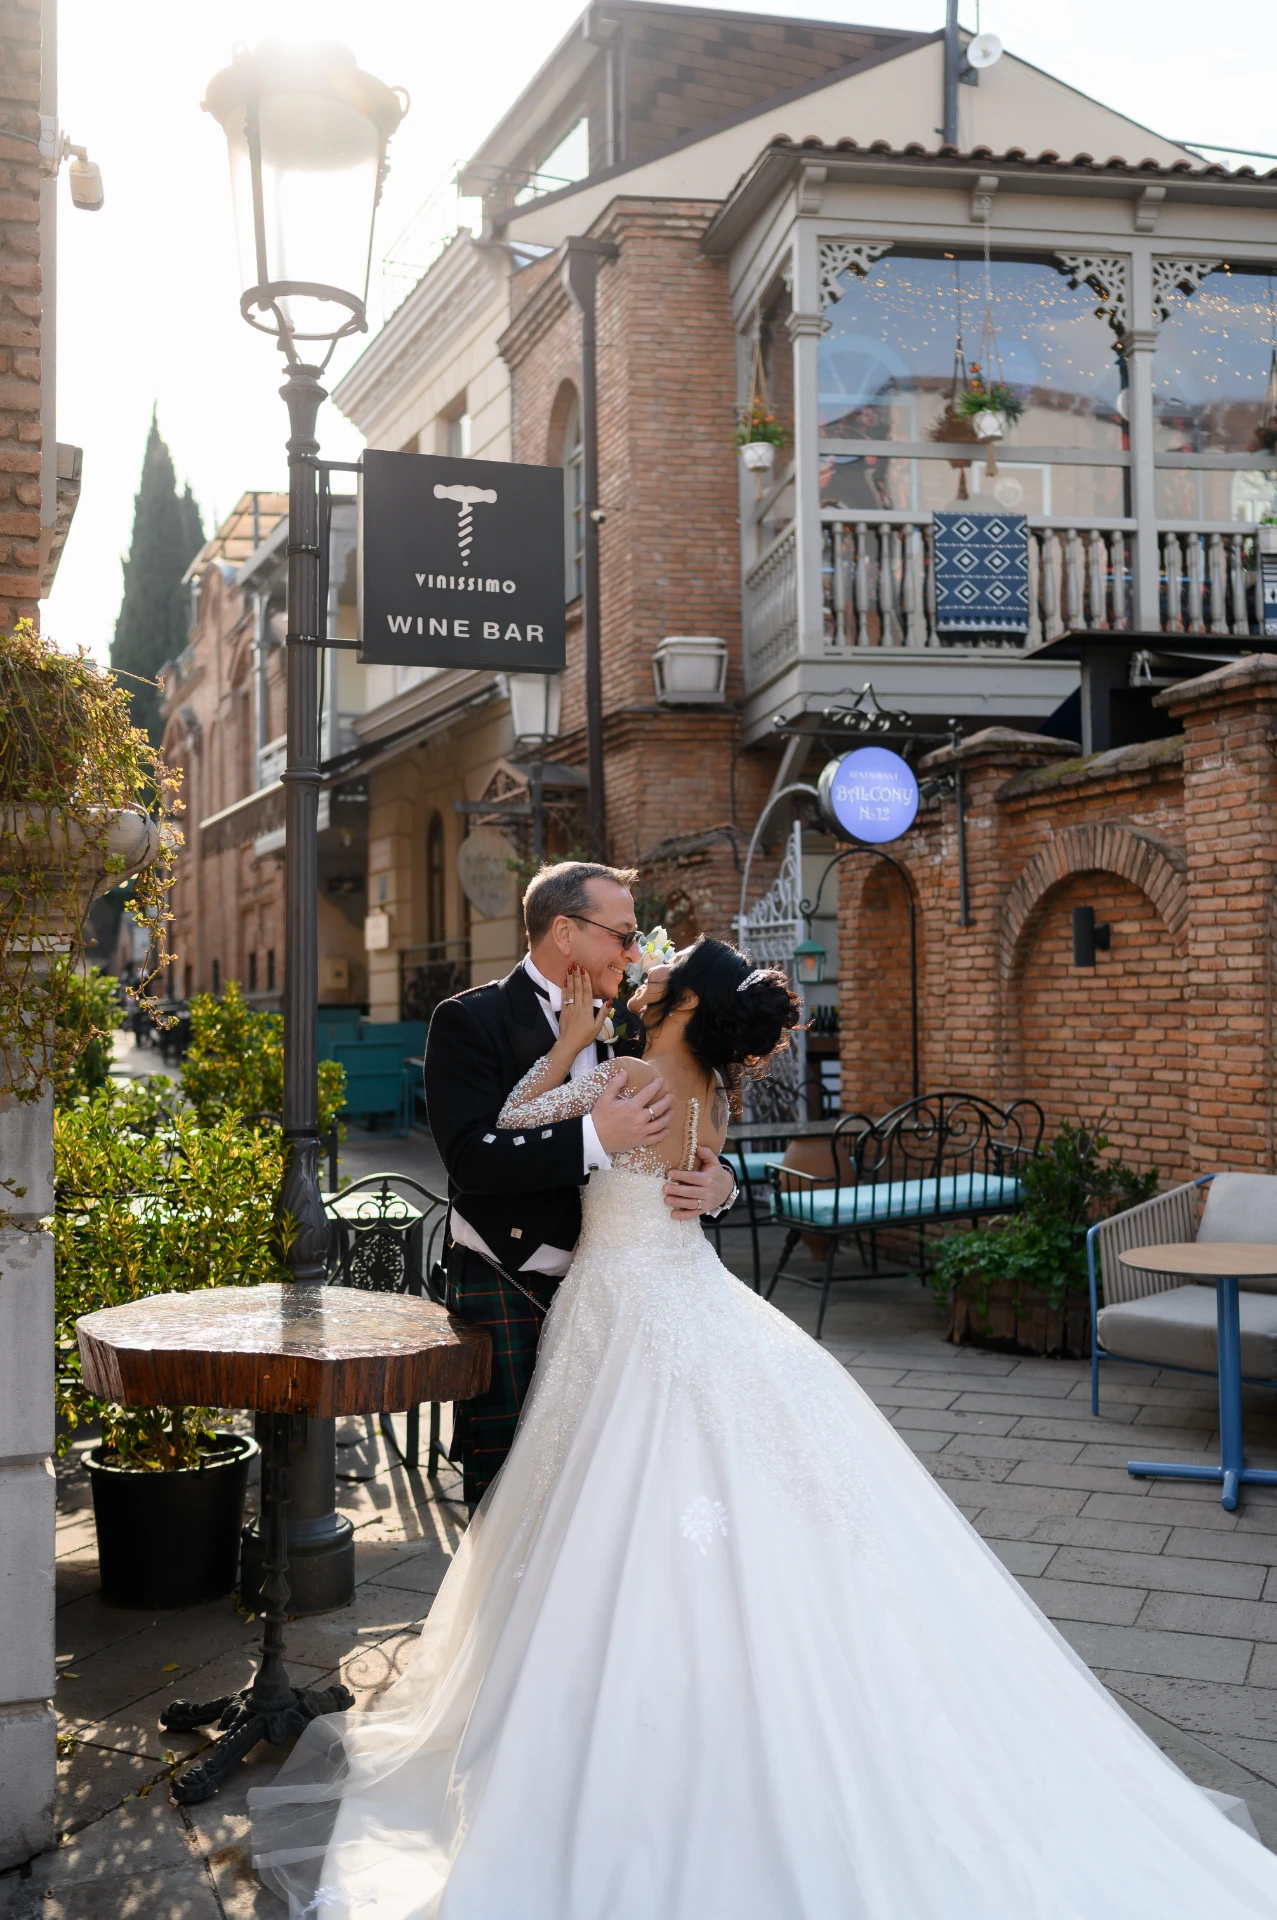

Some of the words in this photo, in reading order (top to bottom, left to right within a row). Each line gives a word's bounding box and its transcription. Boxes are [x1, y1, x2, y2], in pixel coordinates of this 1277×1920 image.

[387, 614, 470, 638] WINE
[483, 621, 544, 643] BAR
[836, 785, 913, 806] BALCONY
